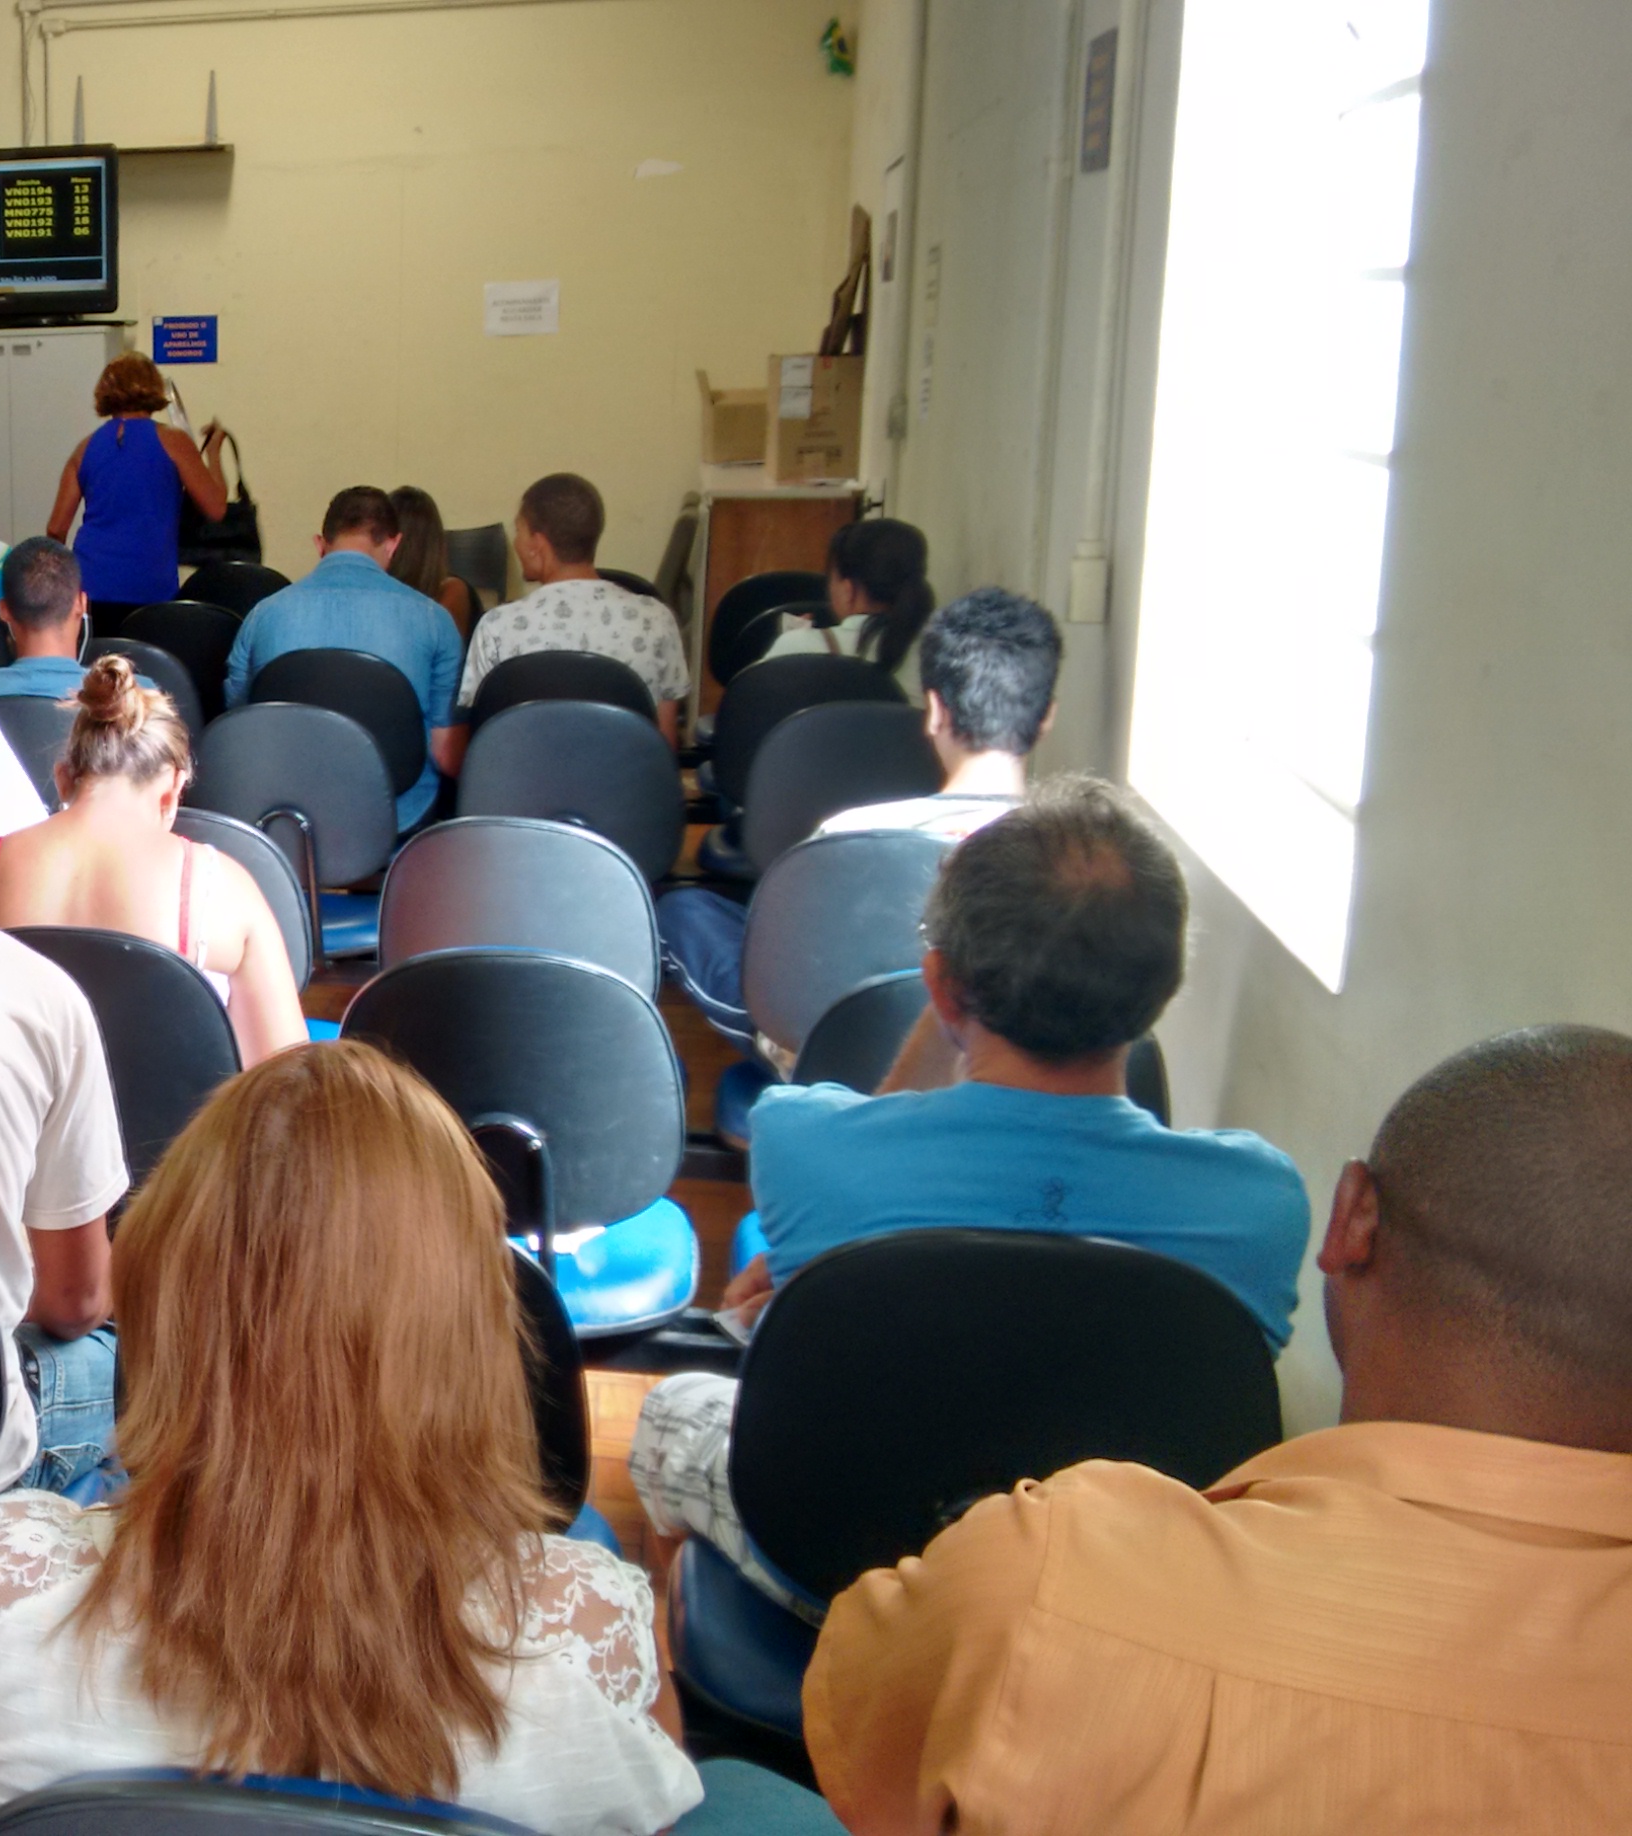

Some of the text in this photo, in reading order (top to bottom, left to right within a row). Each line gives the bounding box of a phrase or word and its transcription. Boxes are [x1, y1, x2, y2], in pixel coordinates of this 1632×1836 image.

[5, 185, 89, 196] VN0194 13
[5, 195, 89, 207] VN0193 15
[4, 206, 90, 217] MN0775 22
[5, 218, 53, 227] VN0192
[5, 227, 90, 238] VN0191 06
